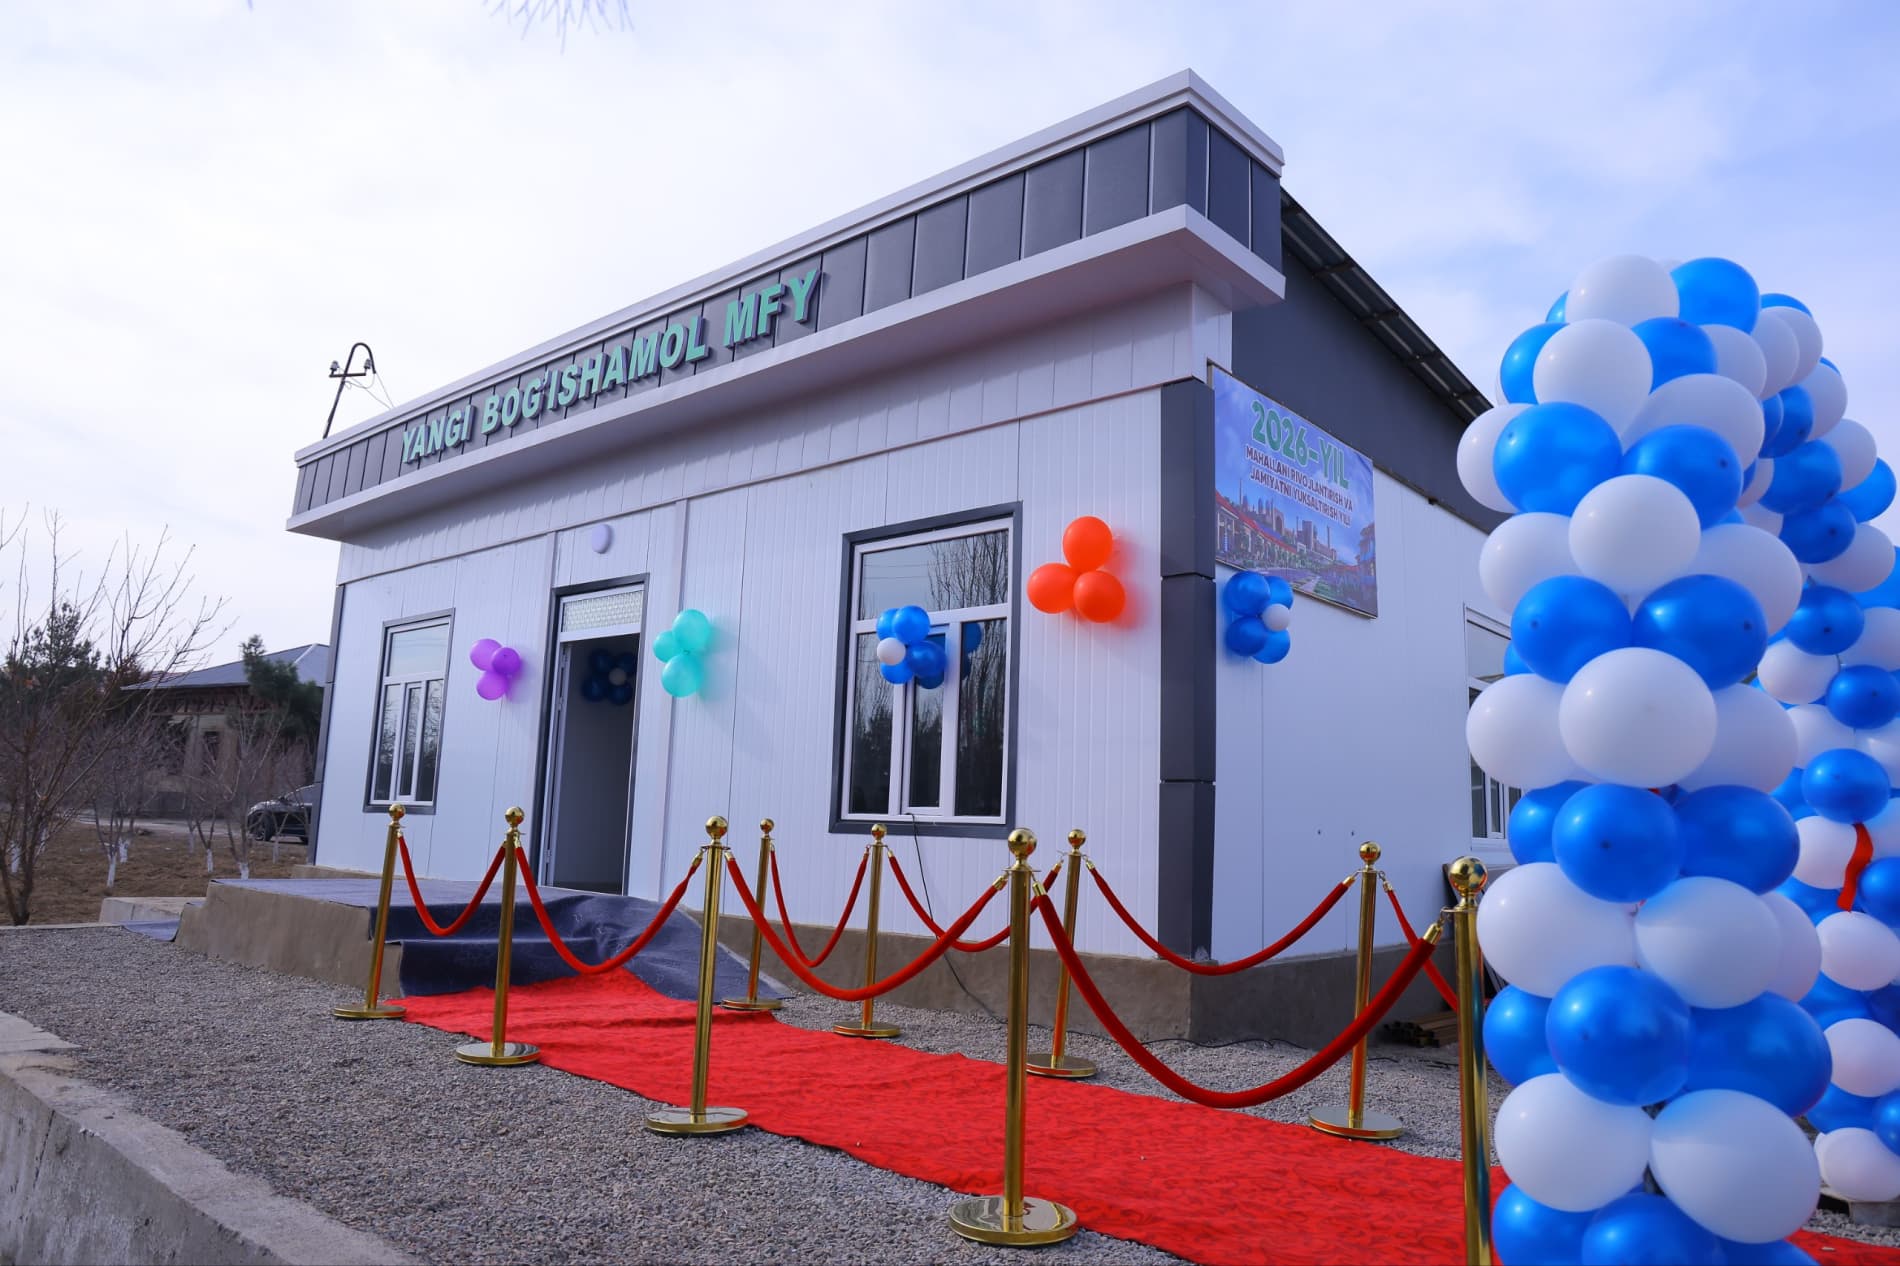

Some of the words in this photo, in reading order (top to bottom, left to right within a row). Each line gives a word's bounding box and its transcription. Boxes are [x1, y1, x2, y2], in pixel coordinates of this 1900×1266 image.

[402, 404, 475, 463] YANGI
[481, 315, 711, 436] BOG'ISHAMOL
[724, 269, 822, 348] MFY
[1246, 445, 1290, 479] MAHALLANI
[1290, 468, 1343, 506] RIVOJLANTIRISH
[1344, 496, 1353, 512] VA
[1251, 400, 1349, 490] 2026-YIL
[1250, 466, 1292, 497] JAMIYATNI
[1293, 488, 1338, 521] YUKSALTIRISH
